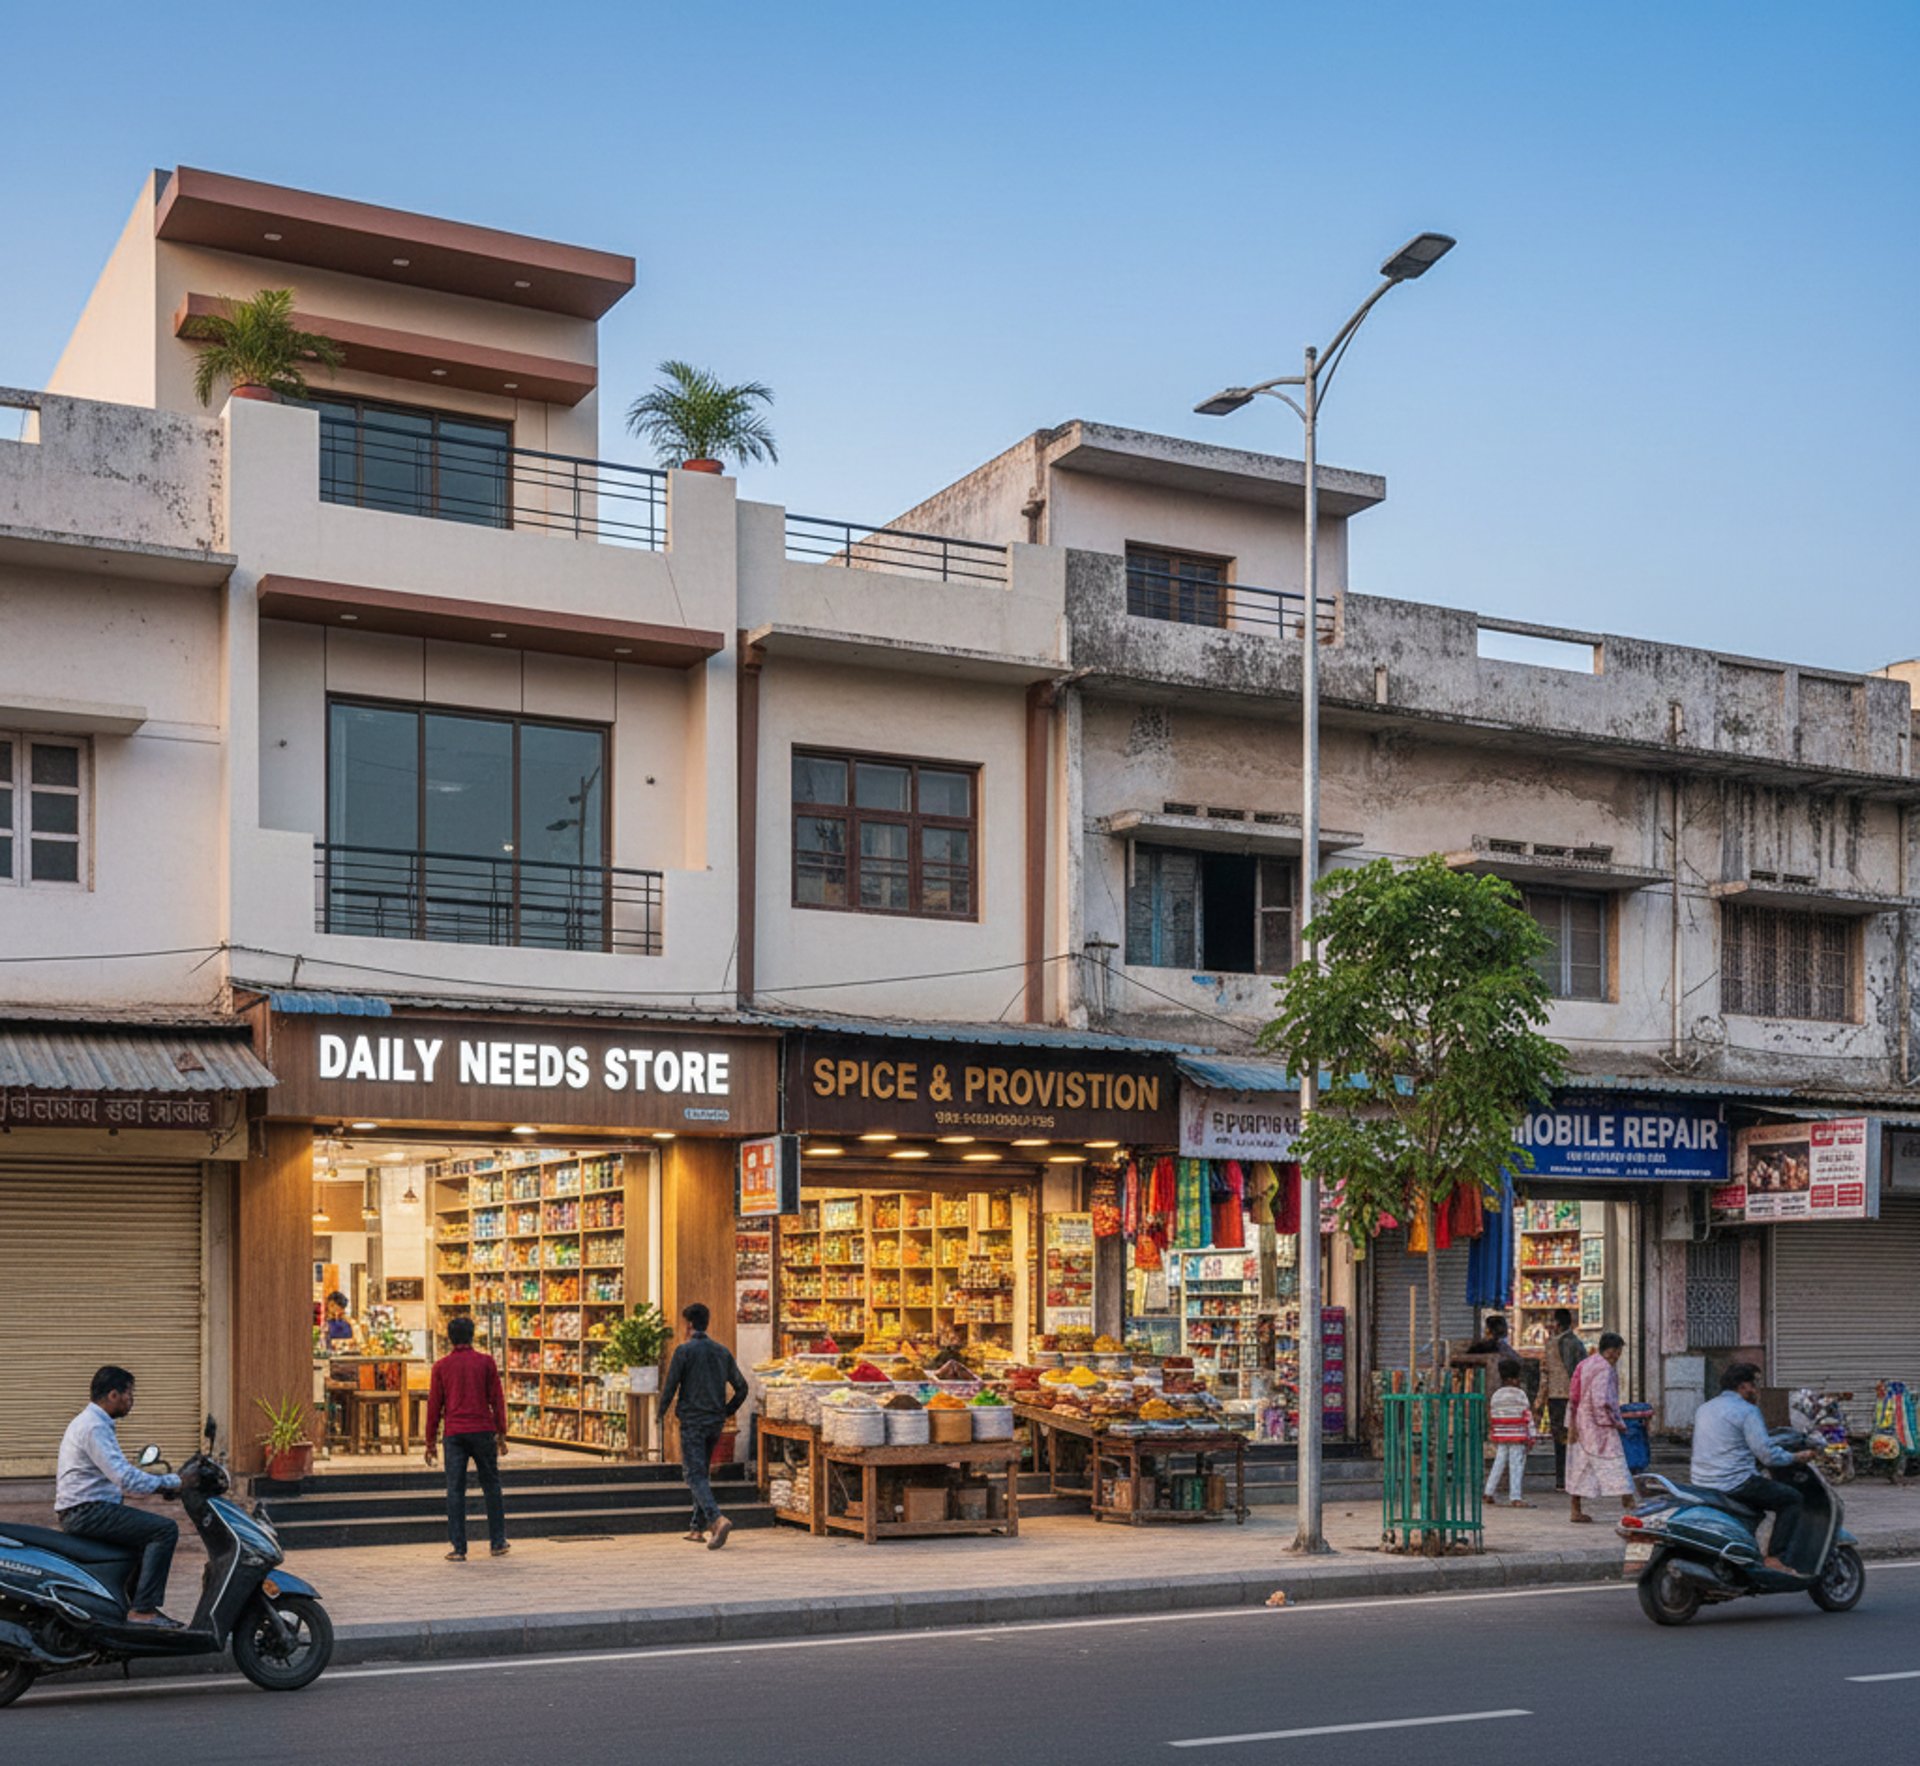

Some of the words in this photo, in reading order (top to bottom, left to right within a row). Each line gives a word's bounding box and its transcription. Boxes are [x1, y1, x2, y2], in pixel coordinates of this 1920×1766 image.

[318, 1034, 444, 1083] DAILY
[459, 1040, 590, 1089] NEEDS
[603, 1047, 731, 1095] STORE
[812, 1057, 919, 1101] SPICE
[928, 1063, 953, 1102] &
[964, 1066, 1160, 1111] PROVISTION
[1622, 1116, 1719, 1150] REPAIR
